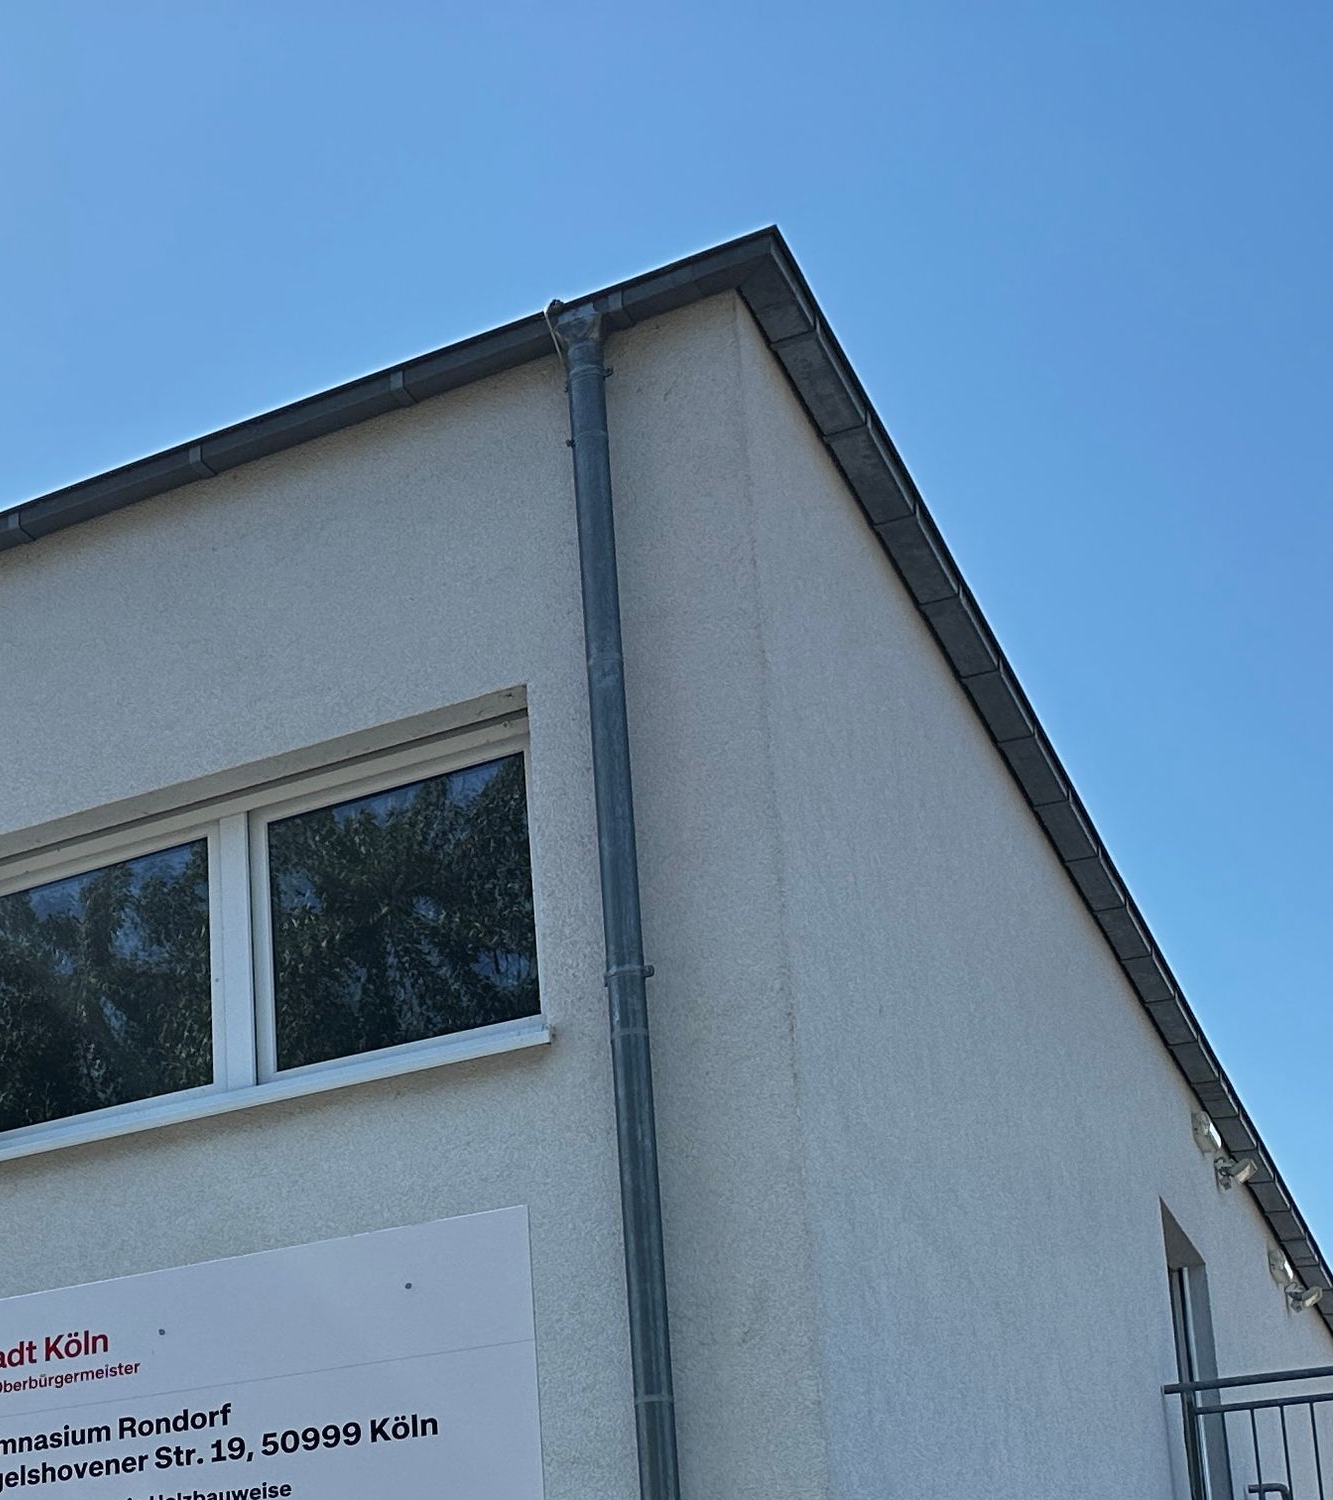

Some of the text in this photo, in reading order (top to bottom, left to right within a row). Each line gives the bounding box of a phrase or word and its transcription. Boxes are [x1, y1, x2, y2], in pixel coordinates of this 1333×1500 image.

[45, 1330, 108, 1362] Köln
[119, 1402, 232, 1440] Rondorf
[154, 1445, 204, 1469] Str.
[211, 1437, 254, 1463] 19,
[261, 1422, 361, 1456] 50999
[370, 1413, 438, 1443] Köln
